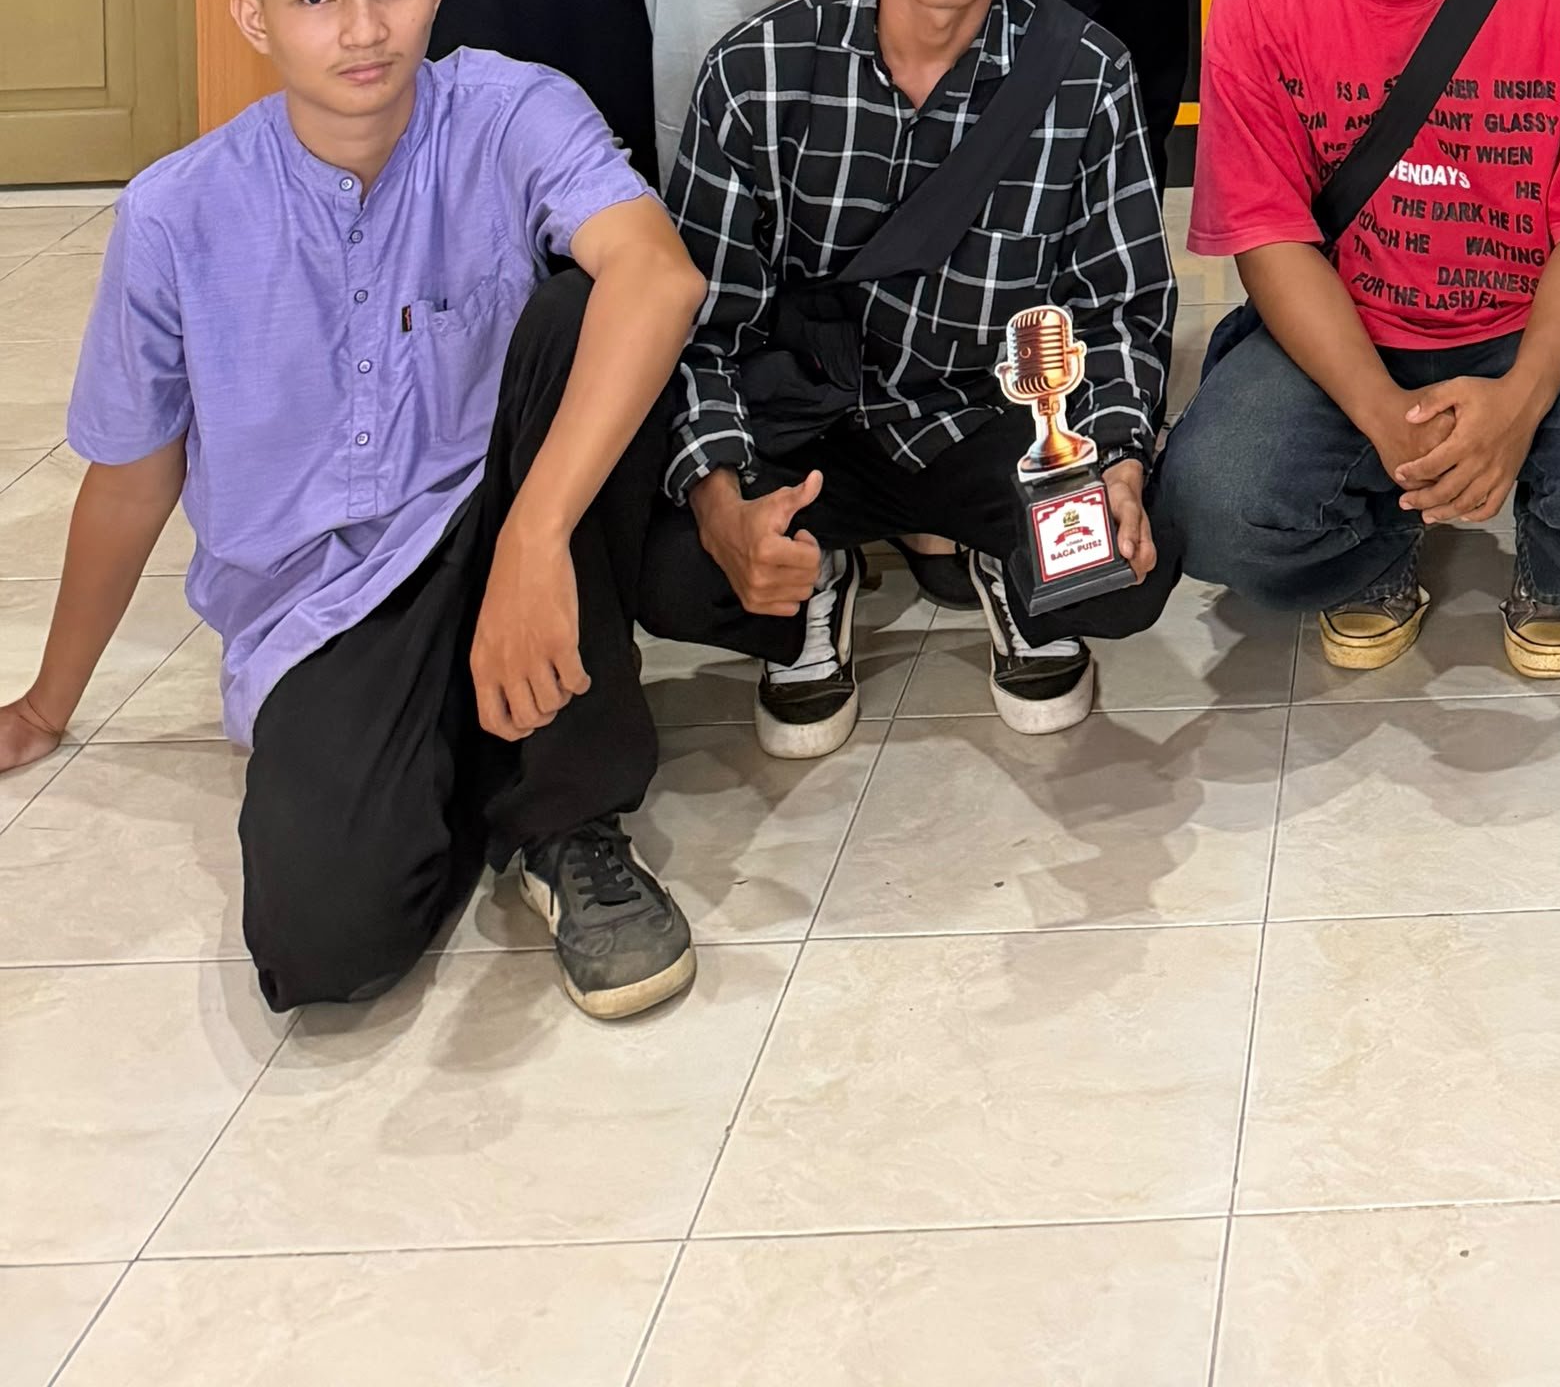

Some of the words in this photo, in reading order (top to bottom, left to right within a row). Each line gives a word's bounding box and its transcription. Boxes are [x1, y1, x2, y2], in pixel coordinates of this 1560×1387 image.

[1357, 83, 1371, 100] A
[1494, 79, 1557, 100] INSIDE
[1484, 113, 1560, 135] GLASSY
[1475, 146, 1534, 166] WHEN
[1516, 181, 1541, 201] HE
[1391, 195, 1427, 219] THE
[1431, 201, 1485, 224] DARK
[1489, 207, 1510, 232] HE
[1516, 214, 1534, 234] IS
[1405, 231, 1431, 254] HE
[1466, 236, 1546, 267] WAITING
[1437, 266, 1540, 297] DARKNESS
